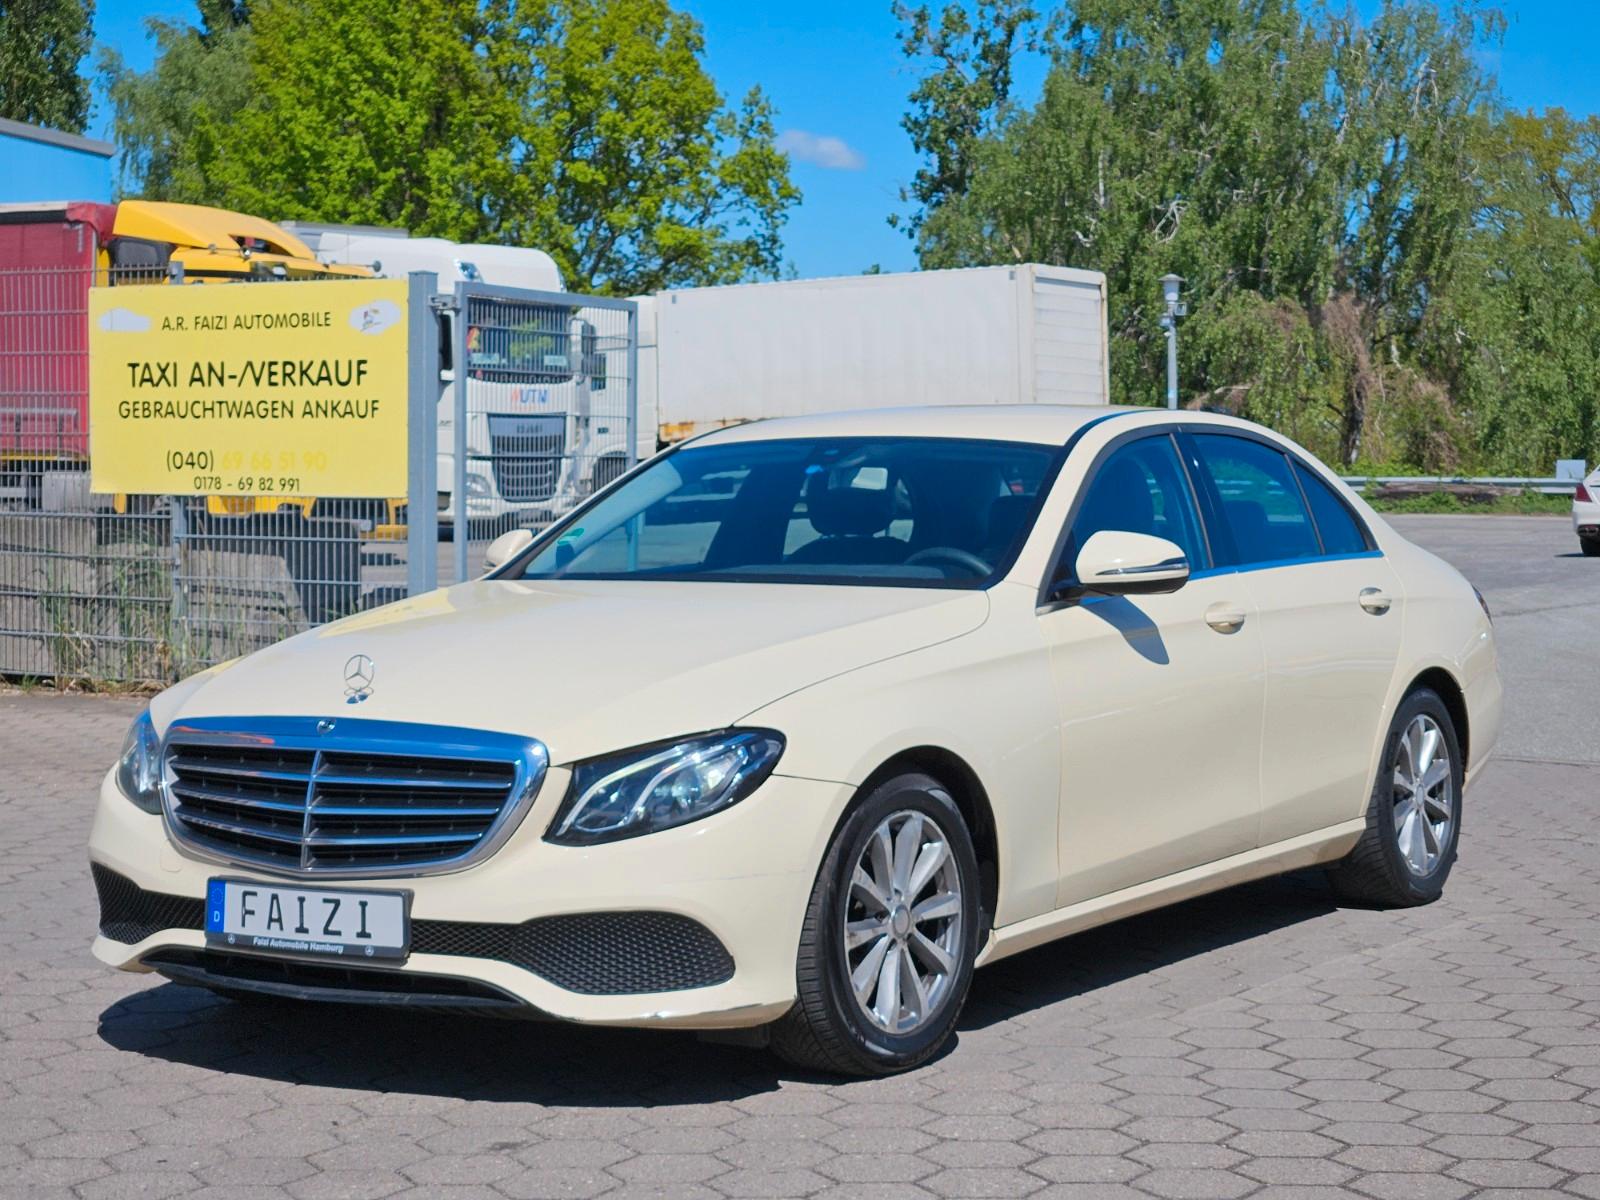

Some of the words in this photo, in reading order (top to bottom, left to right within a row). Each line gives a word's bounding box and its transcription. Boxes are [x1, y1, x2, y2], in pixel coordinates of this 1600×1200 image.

[162, 315, 188, 331] A.R.
[194, 315, 227, 330] FAIZI
[233, 312, 331, 330] AUTOMOBILE
[127, 362, 178, 388] TAXI
[118, 400, 294, 419] GEBRAUCHTWAGEN
[302, 399, 380, 418] ANKAUF
[166, 450, 214, 472] (040)
[193, 476, 222, 491] 0178
[238, 477, 253, 491] 69
[258, 477, 274, 491] 82
[279, 478, 300, 492] 991
[213, 910, 221, 922] D
[241, 890, 372, 939] FAIZI
[270, 938, 309, 950] Automobile
[310, 942, 344, 955] Hamburg
